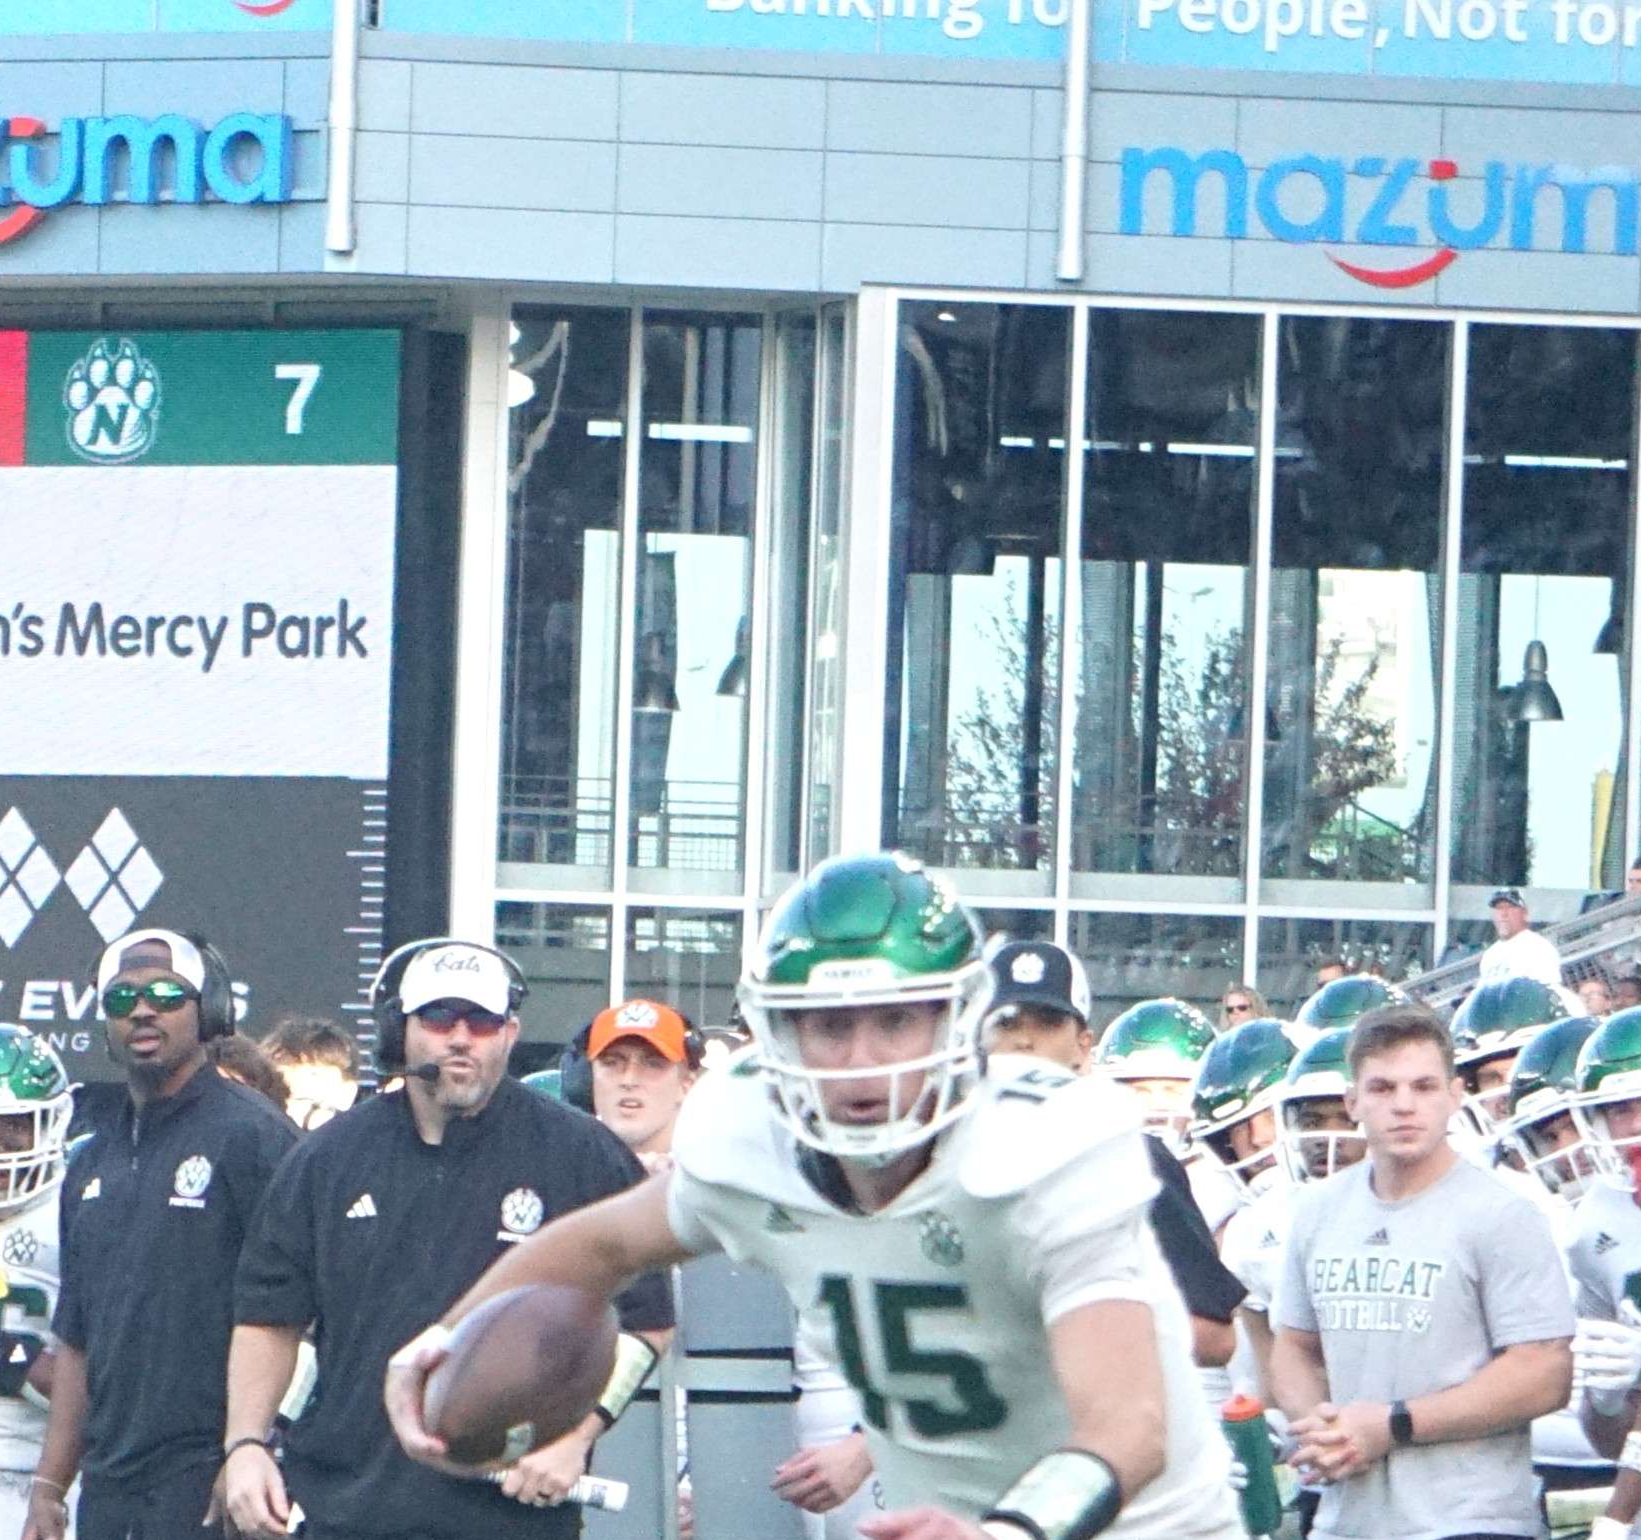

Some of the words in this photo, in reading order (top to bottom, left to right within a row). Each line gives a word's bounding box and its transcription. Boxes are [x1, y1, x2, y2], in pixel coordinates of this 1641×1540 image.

[1403, 0, 1527, 42] Not
[274, 363, 321, 435] 7
[57, 601, 229, 673] Mercy
[240, 598, 368, 661] Park
[1313, 1256, 1442, 1298] BEARCAT
[817, 1273, 1010, 1439] 15
